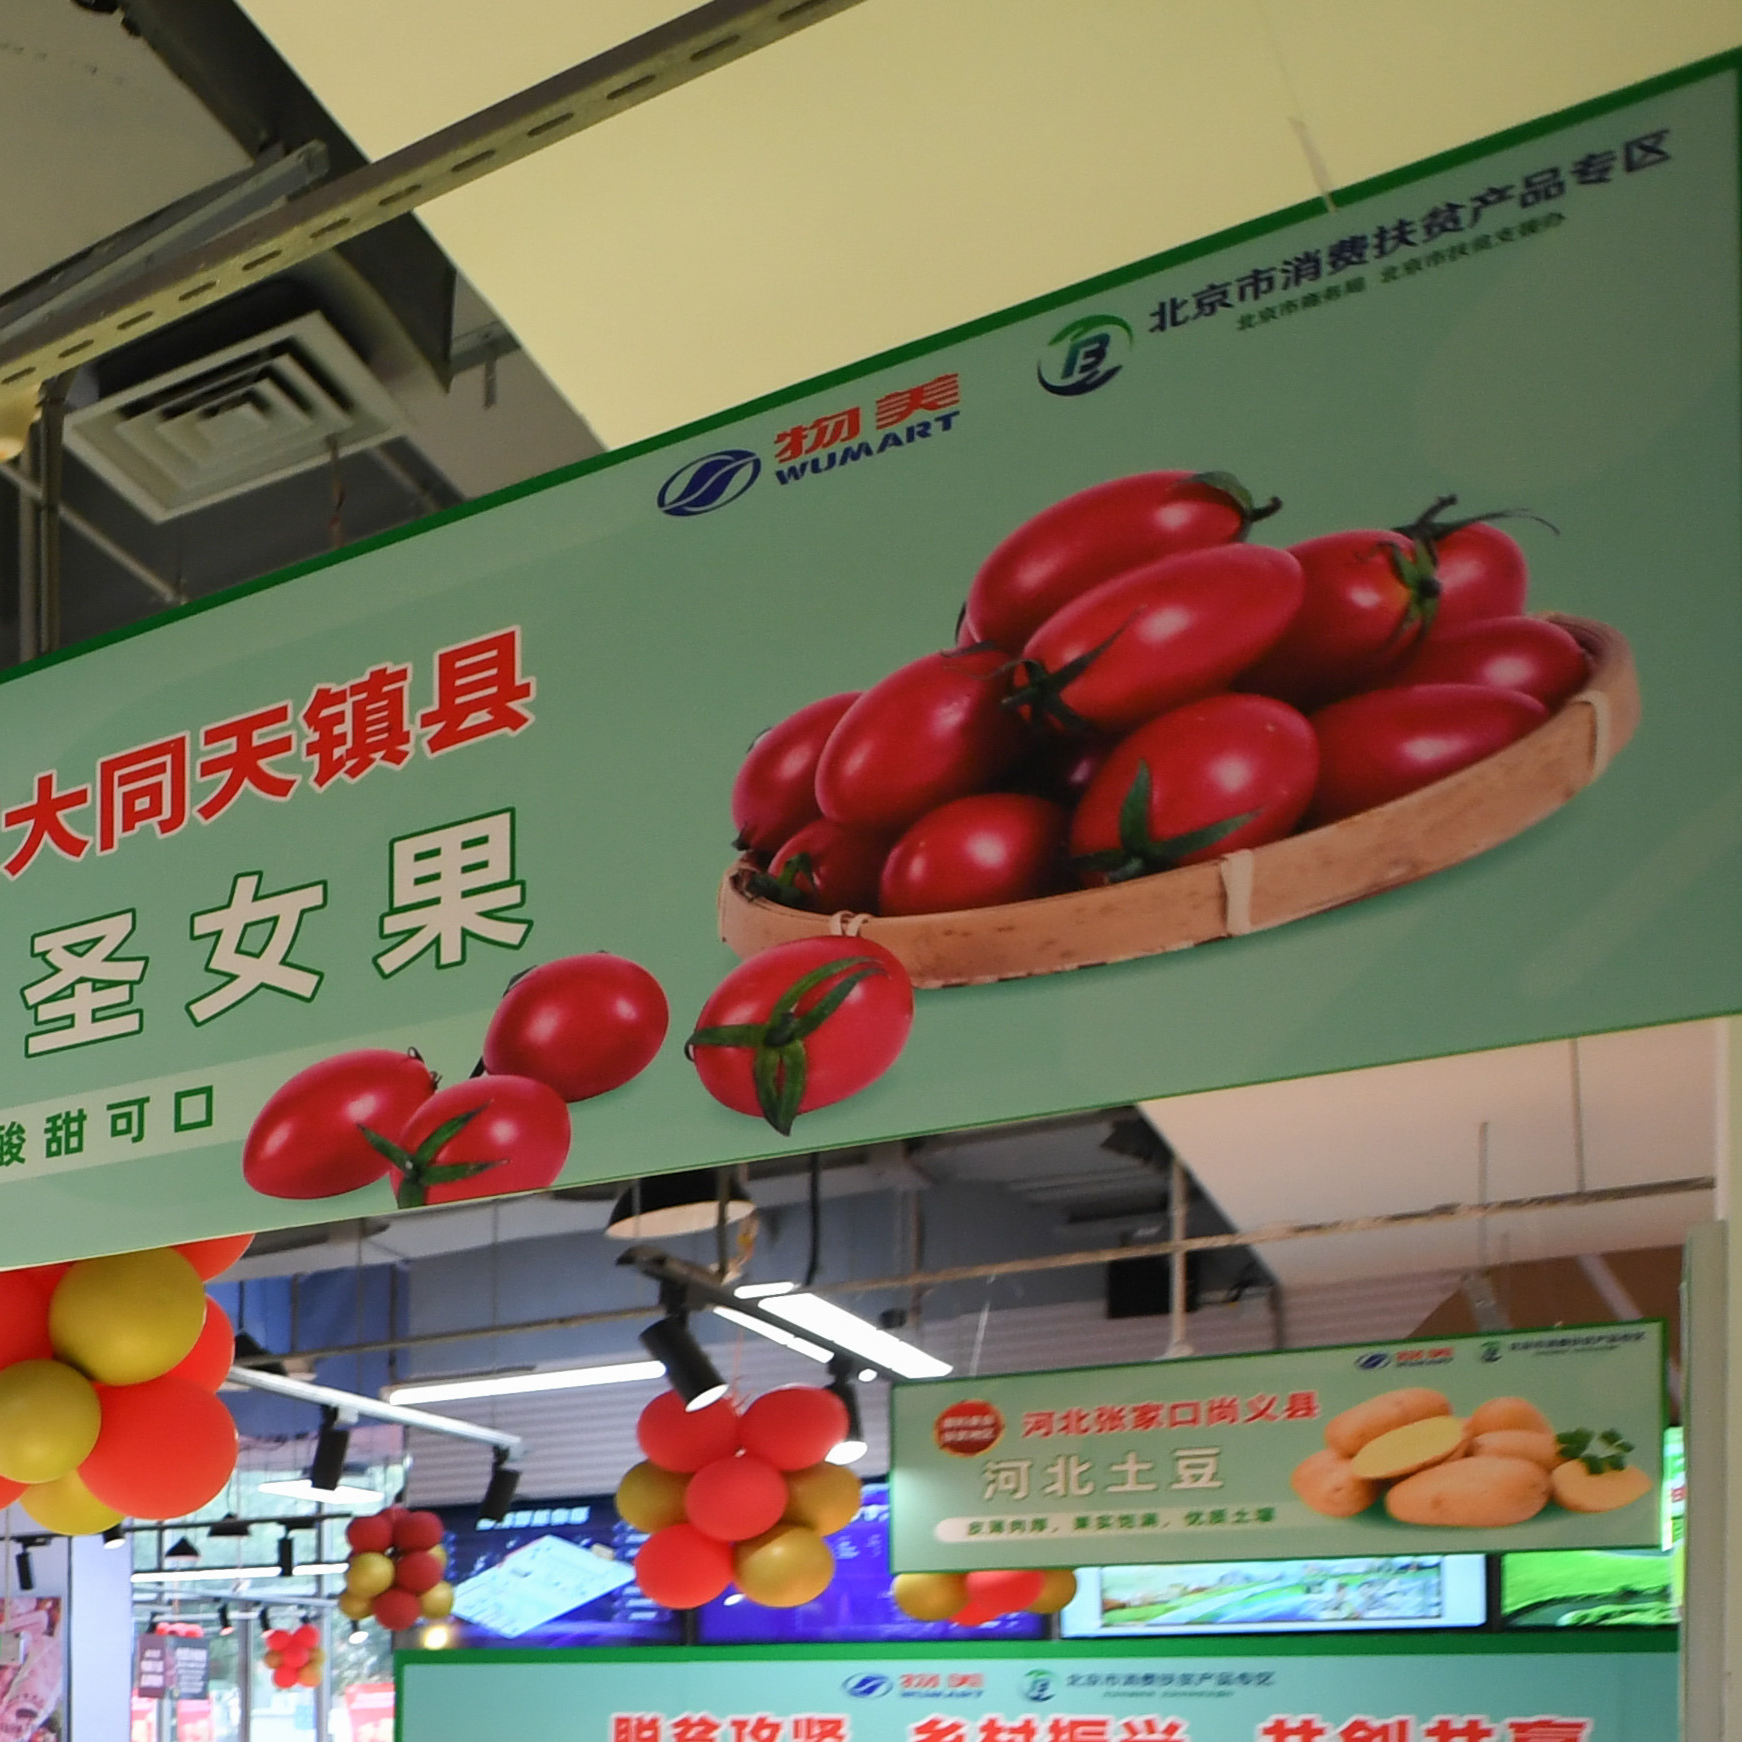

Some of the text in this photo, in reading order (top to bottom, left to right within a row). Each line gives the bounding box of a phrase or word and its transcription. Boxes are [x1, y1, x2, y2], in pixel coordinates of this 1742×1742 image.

[1148, 128, 1671, 334] 北京市消费扶贫产品专区
[773, 373, 960, 463] 物美
[775, 412, 960, 485] WUMART
[1023, 1391, 1319, 1437] 河北张家口尚义县
[982, 1447, 1224, 1500] 河北土豆
